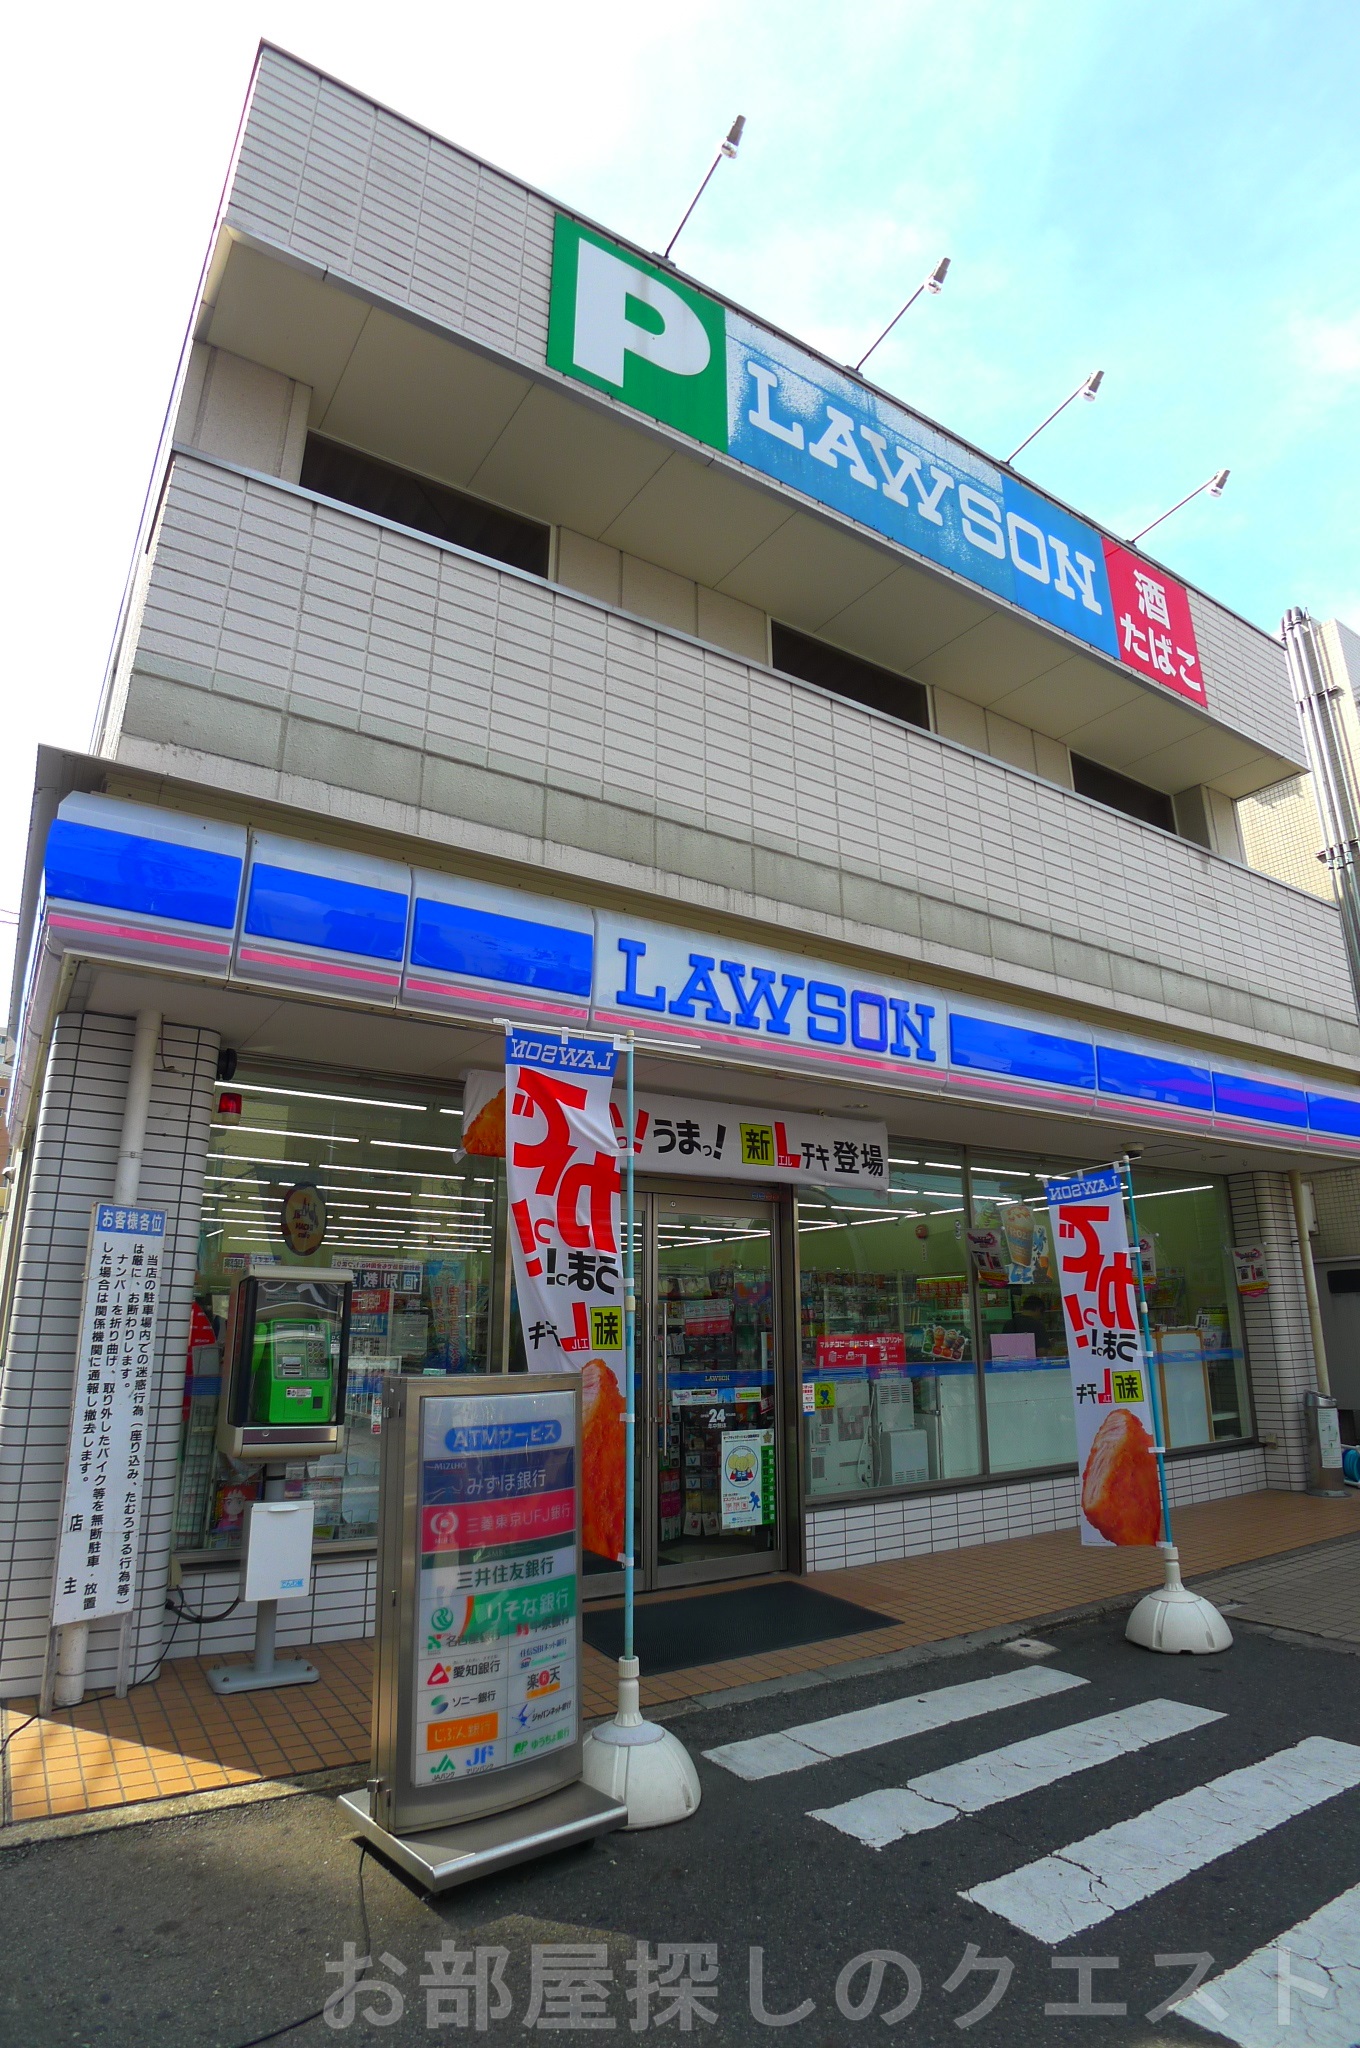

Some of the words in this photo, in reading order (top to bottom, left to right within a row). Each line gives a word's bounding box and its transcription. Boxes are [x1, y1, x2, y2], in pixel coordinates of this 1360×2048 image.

[573, 237, 711, 388] P
[746, 360, 1102, 616] LAWSON
[1133, 568, 1171, 629] 酒
[1119, 613, 1202, 692] たばこ
[616, 938, 936, 1062] LAWSON
[102, 1208, 163, 1233] お客様各位
[708, 1408, 726, 1423] 24
[453, 1423, 557, 1448] ATMサービス
[466, 1469, 547, 1495] みずほ銀行
[466, 1503, 571, 1534] 三菱東京UFJ銀行
[456, 1556, 554, 1590] 三井住友銀行
[487, 1588, 569, 1625] りそな銀行
[453, 1660, 500, 1679] 愛知銀行
[452, 1690, 496, 1708] ソニー銀行
[434, 1721, 491, 1743] じぶん銀行
[531, 1726, 570, 1750] ゆうちょ銀行
